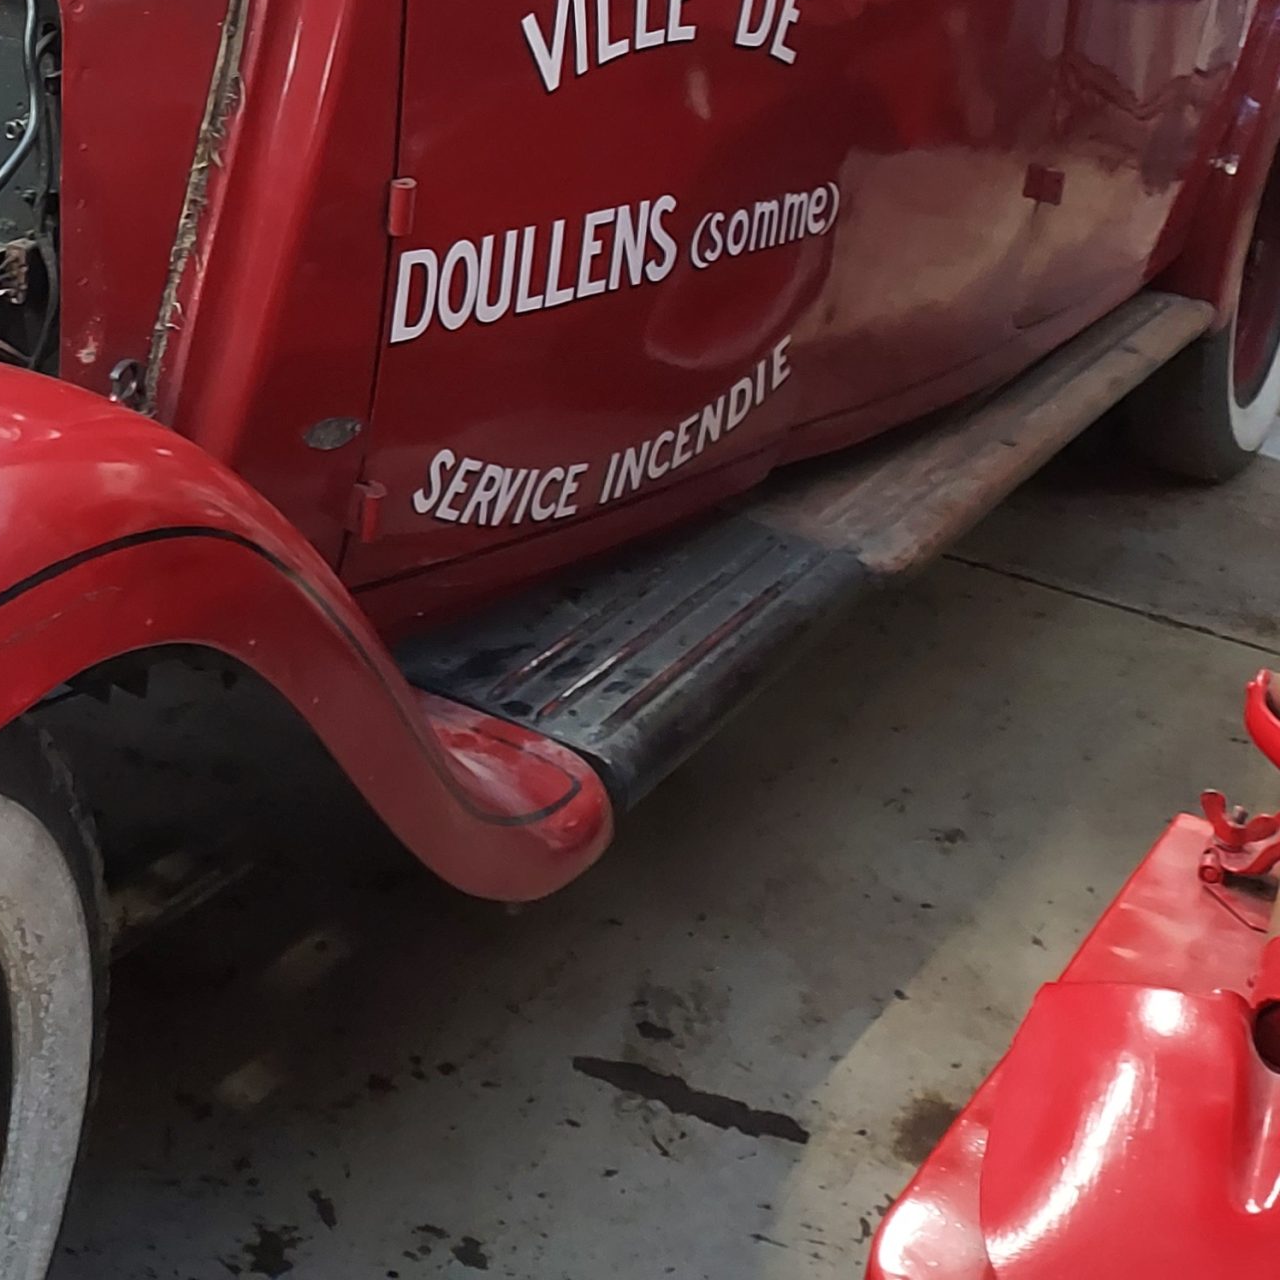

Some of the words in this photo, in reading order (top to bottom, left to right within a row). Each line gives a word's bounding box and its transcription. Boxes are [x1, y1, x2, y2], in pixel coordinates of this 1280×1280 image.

[390, 194, 677, 344] DOULLENS
[689, 182, 841, 270] (somme)
[413, 448, 589, 526] SERVICE
[599, 334, 792, 505] INCENDIE
